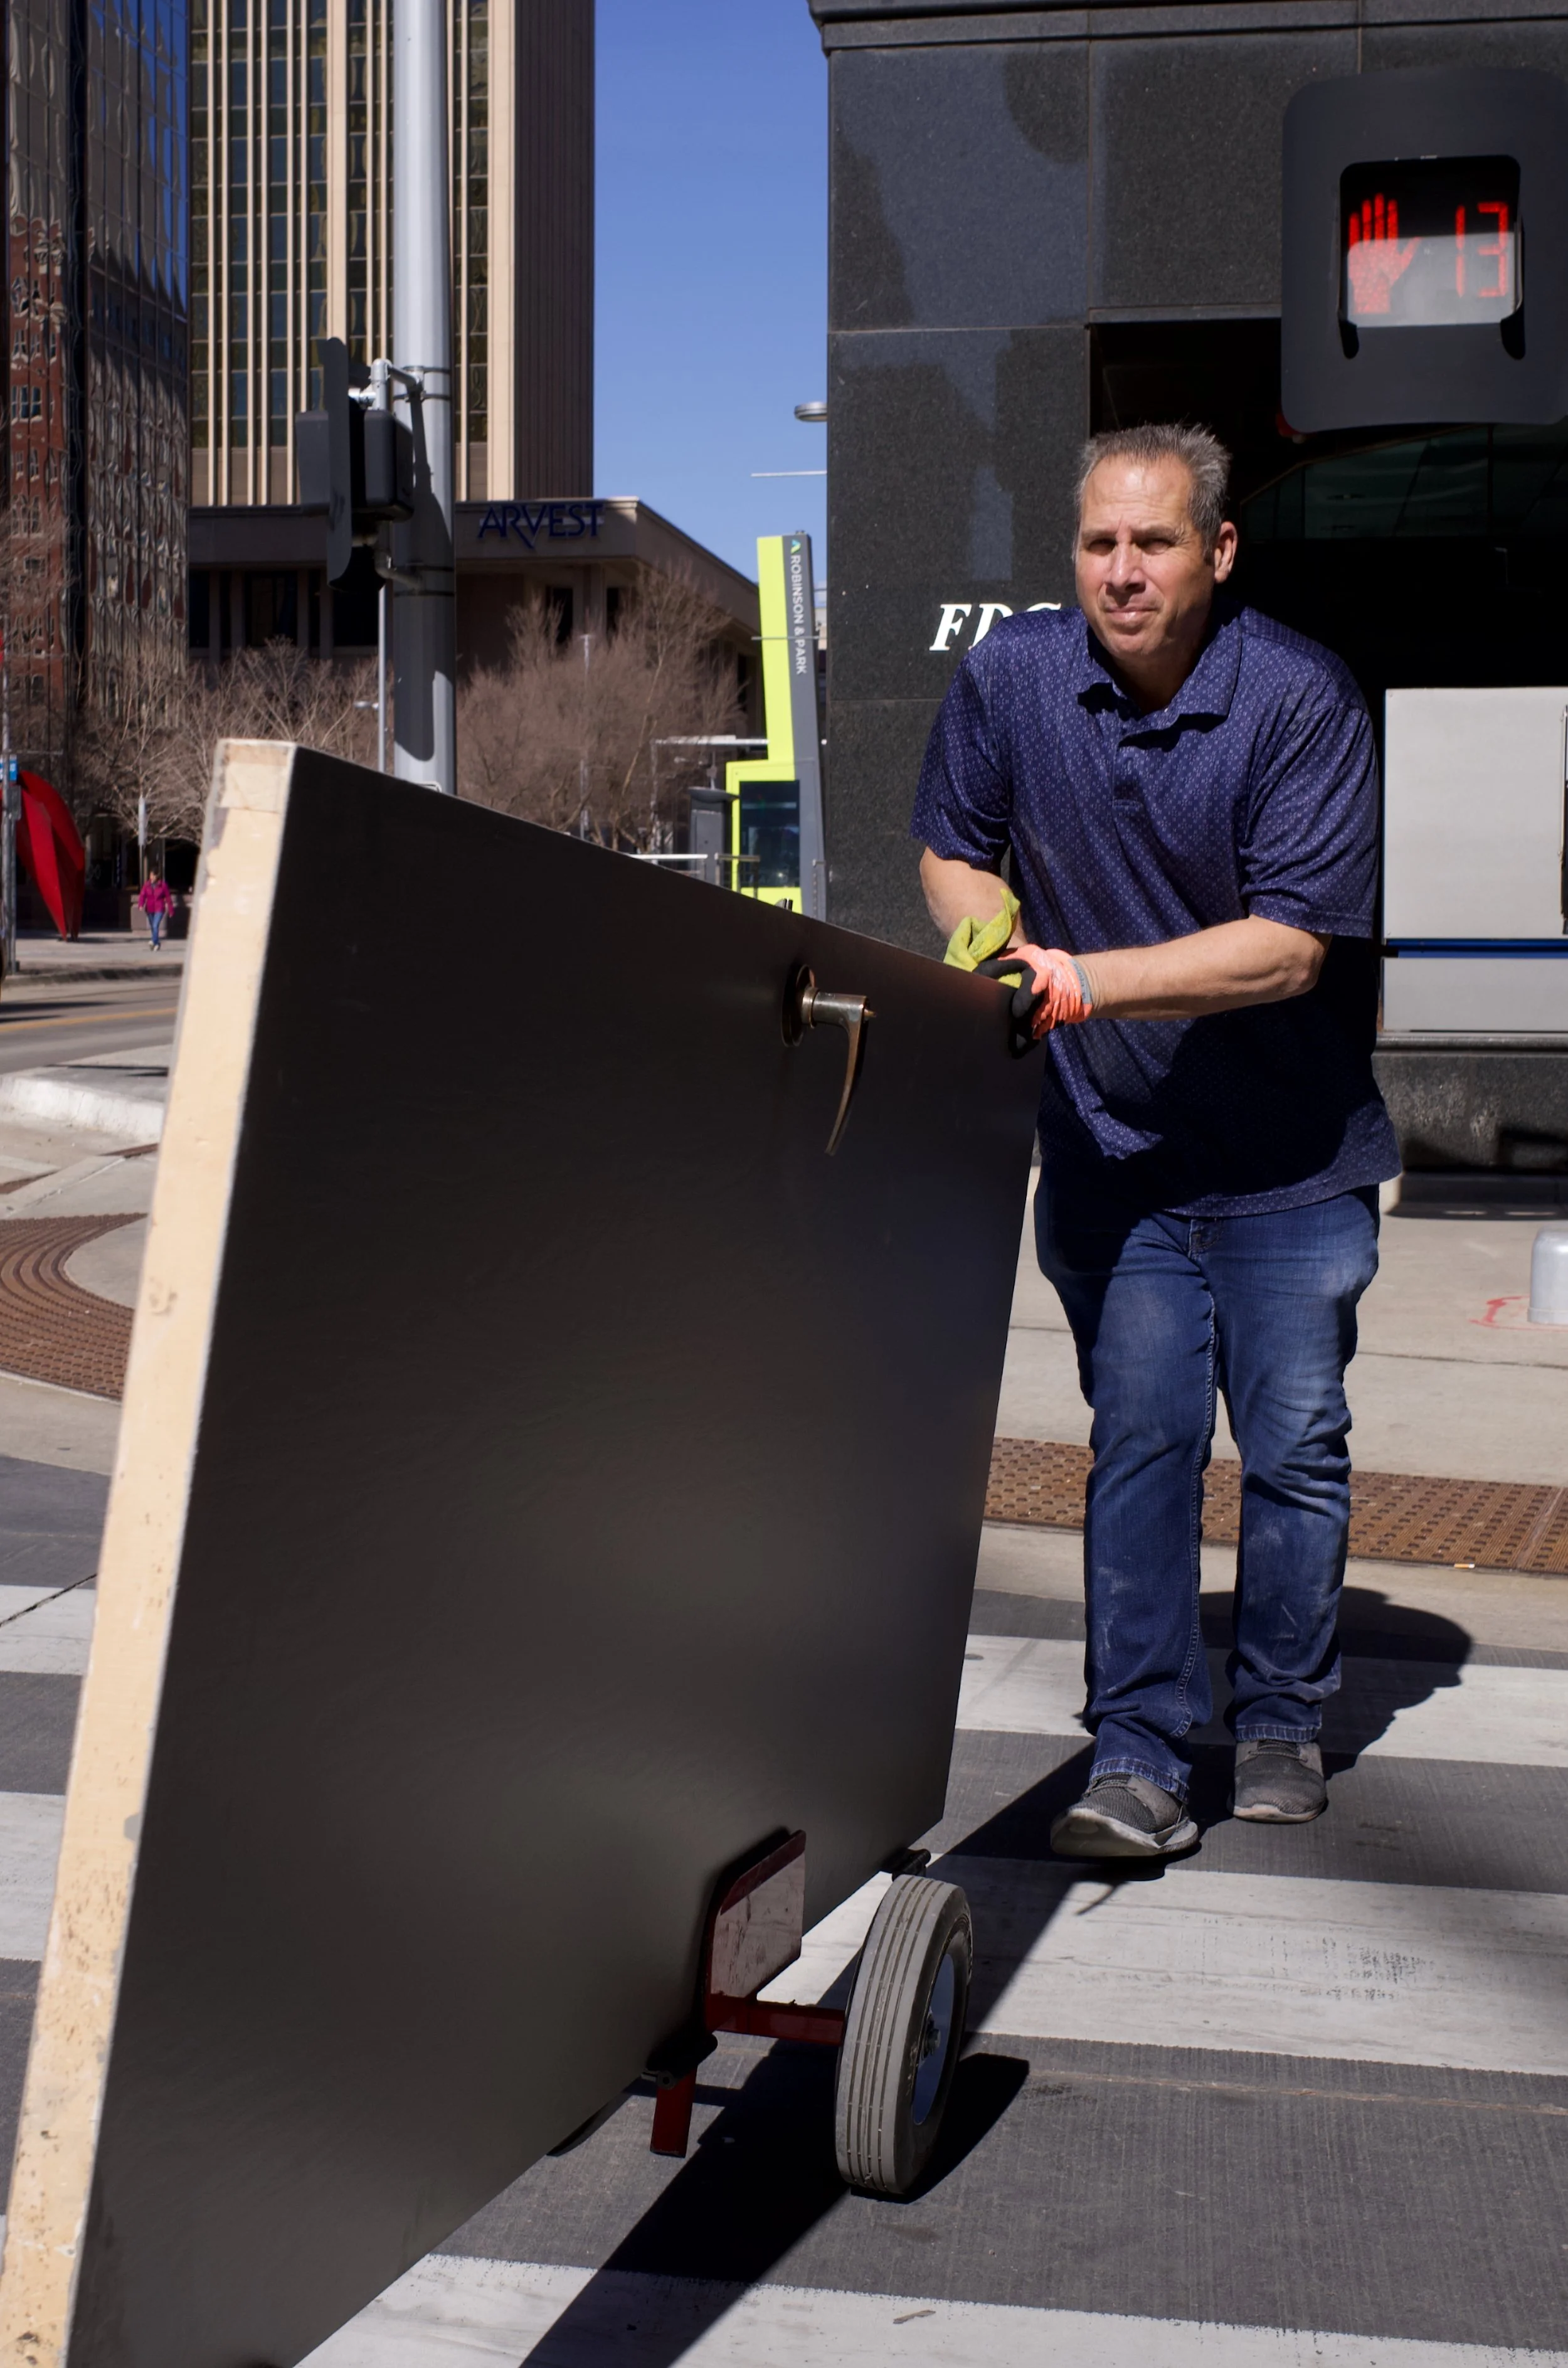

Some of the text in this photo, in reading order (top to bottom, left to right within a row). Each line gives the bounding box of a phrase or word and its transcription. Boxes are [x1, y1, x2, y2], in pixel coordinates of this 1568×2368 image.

[1455, 201, 1508, 298] 13
[477, 504, 603, 549] ARVEST
[790, 555, 807, 675] ROBINSON & PARK
